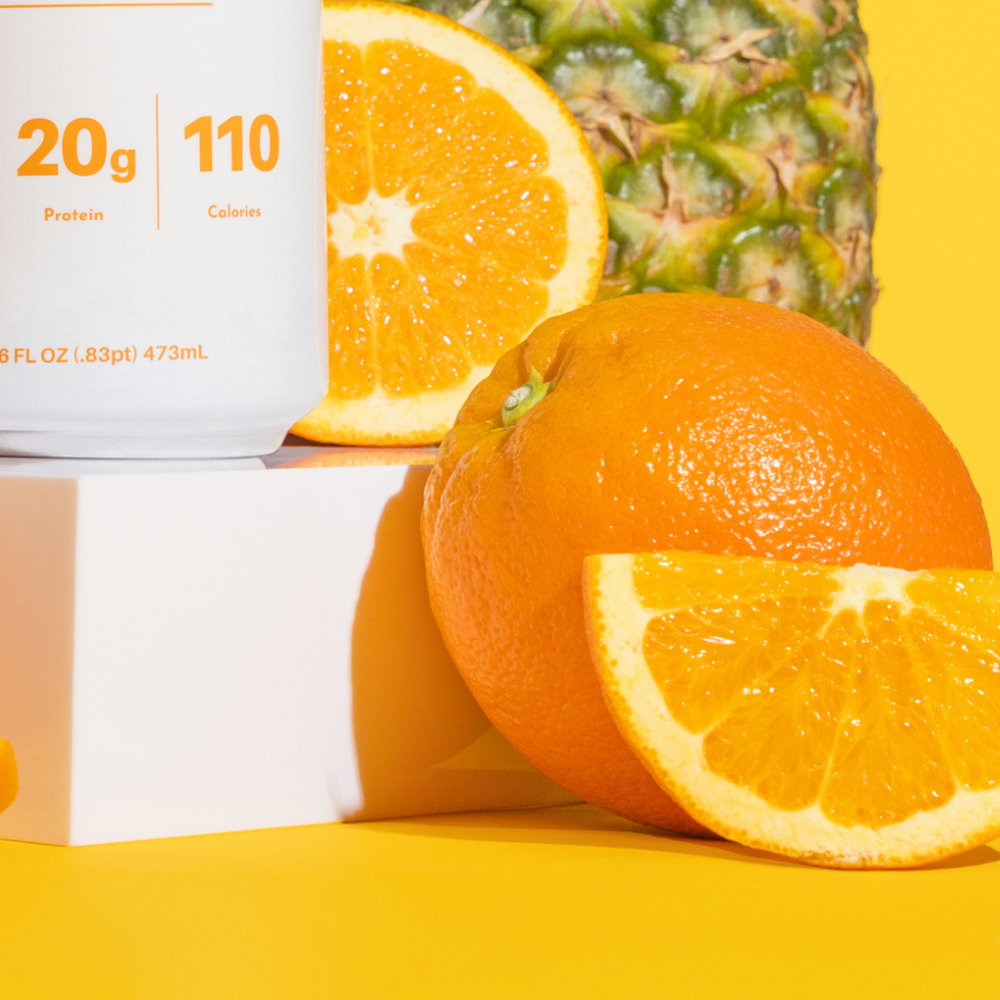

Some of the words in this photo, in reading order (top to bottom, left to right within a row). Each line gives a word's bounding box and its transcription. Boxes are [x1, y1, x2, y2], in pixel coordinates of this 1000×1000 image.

[16, 117, 137, 184] 20g
[183, 113, 280, 173] 110
[44, 207, 104, 222] Protein
[207, 203, 262, 219] Calories
[13, 347, 37, 364] FL
[40, 347, 69, 364] OZ
[73, 345, 138, 366] (.83pt)
[143, 344, 209, 361] 473mL
